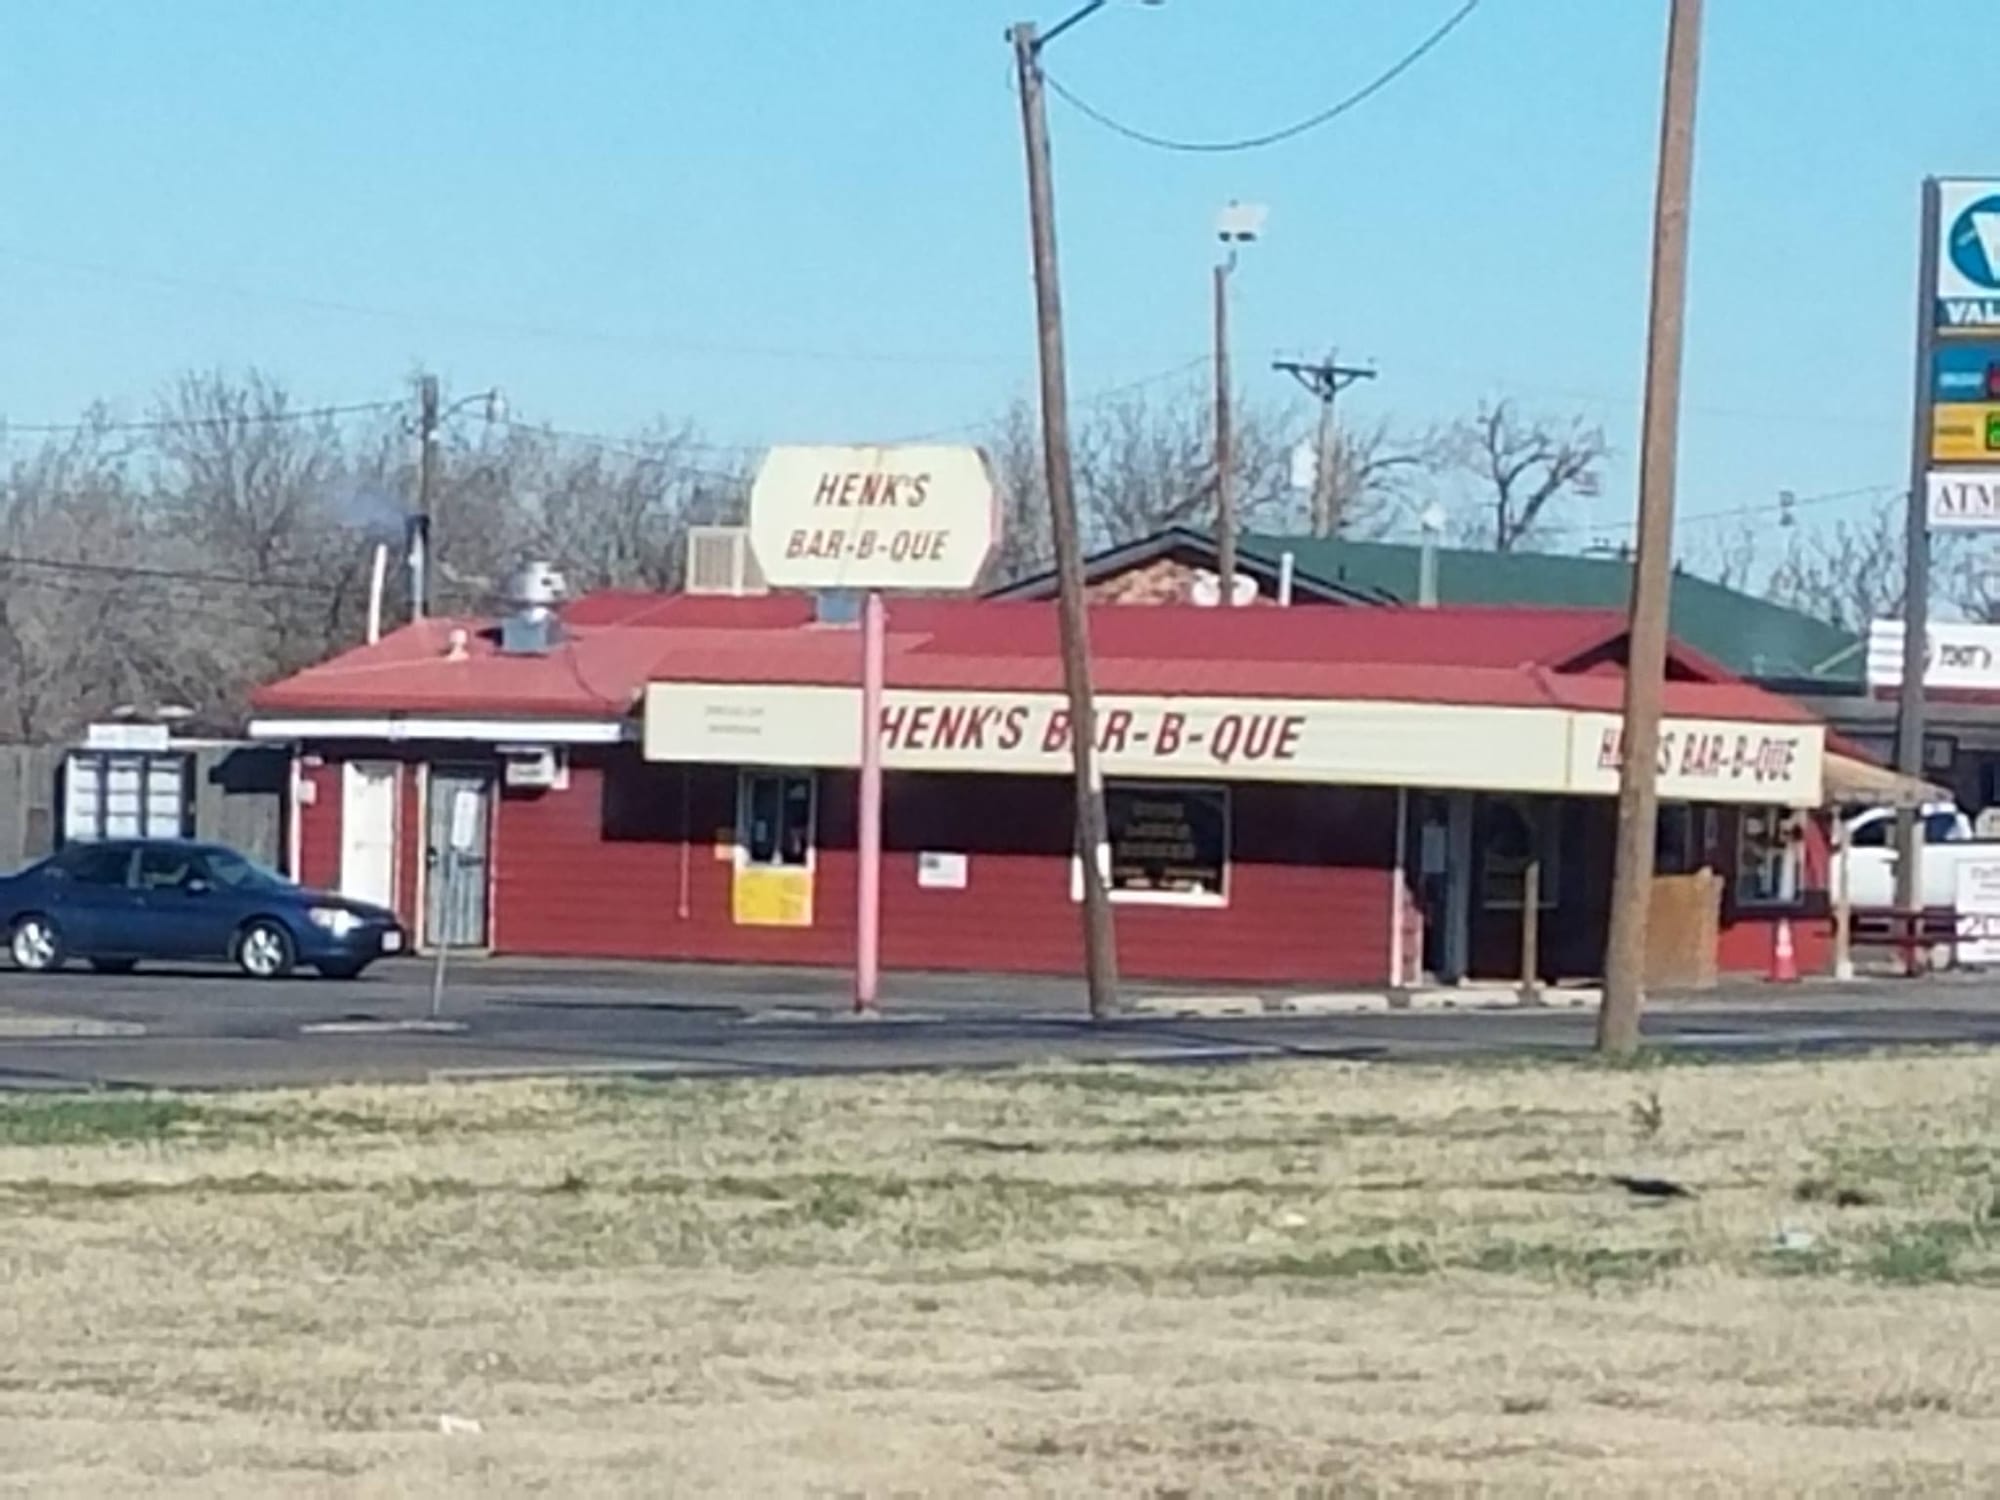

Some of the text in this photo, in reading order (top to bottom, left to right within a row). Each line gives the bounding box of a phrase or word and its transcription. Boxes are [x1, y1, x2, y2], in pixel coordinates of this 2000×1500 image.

[813, 472, 931, 507] HENK'S
[785, 529, 950, 562] BAR-B-QUE
[880, 706, 1307, 765] HENK'S BR-B-QUE
[1679, 732, 1799, 782] BAR-B-QUE
